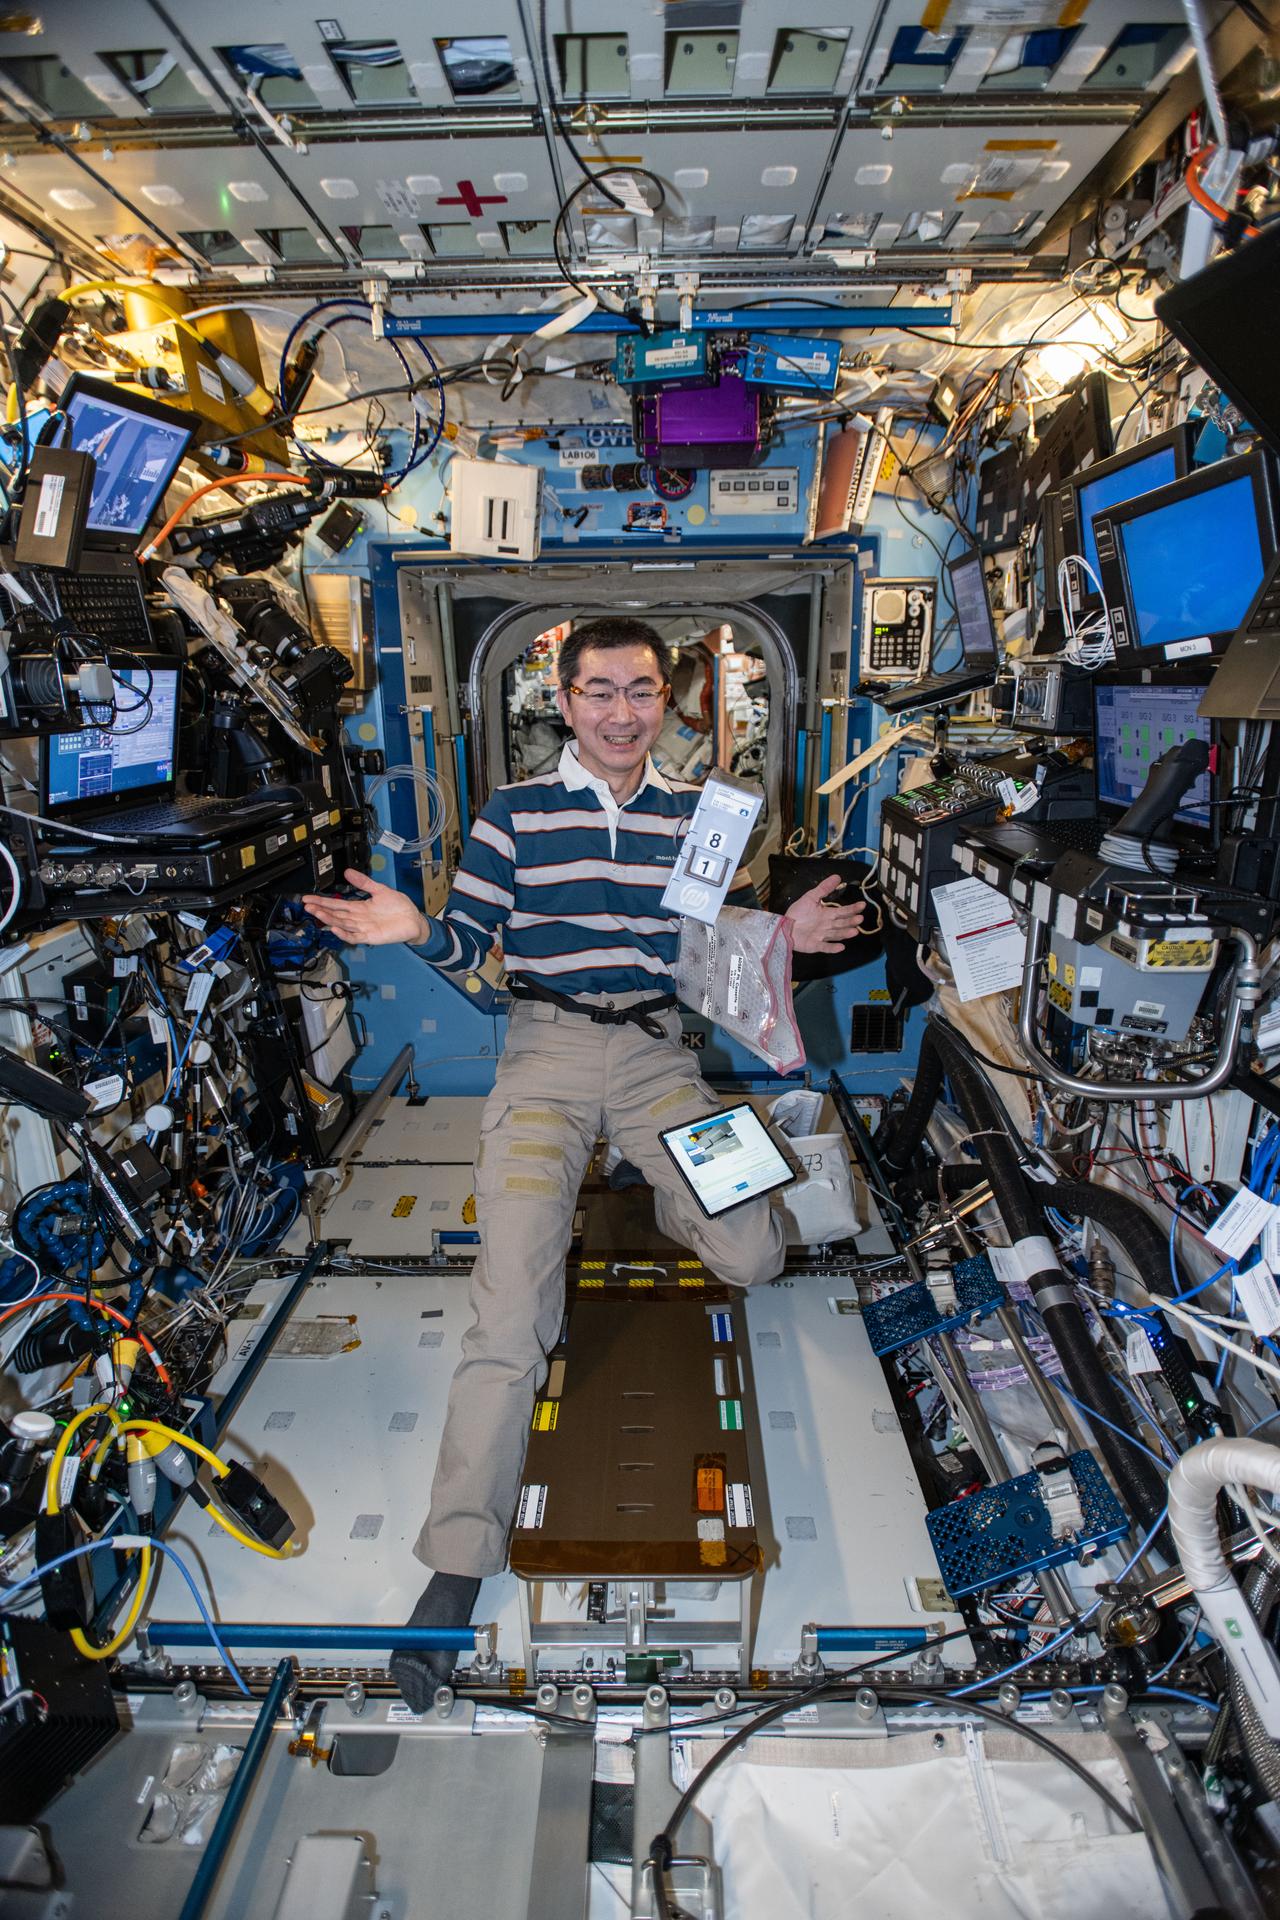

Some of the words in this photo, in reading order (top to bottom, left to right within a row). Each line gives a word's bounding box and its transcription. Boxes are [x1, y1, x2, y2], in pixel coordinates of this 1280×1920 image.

[847, 447, 865, 510] WARNING
[709, 833, 722, 849] 8
[701, 860, 709, 875] 1
[238, 1338, 256, 1358] AV-1
